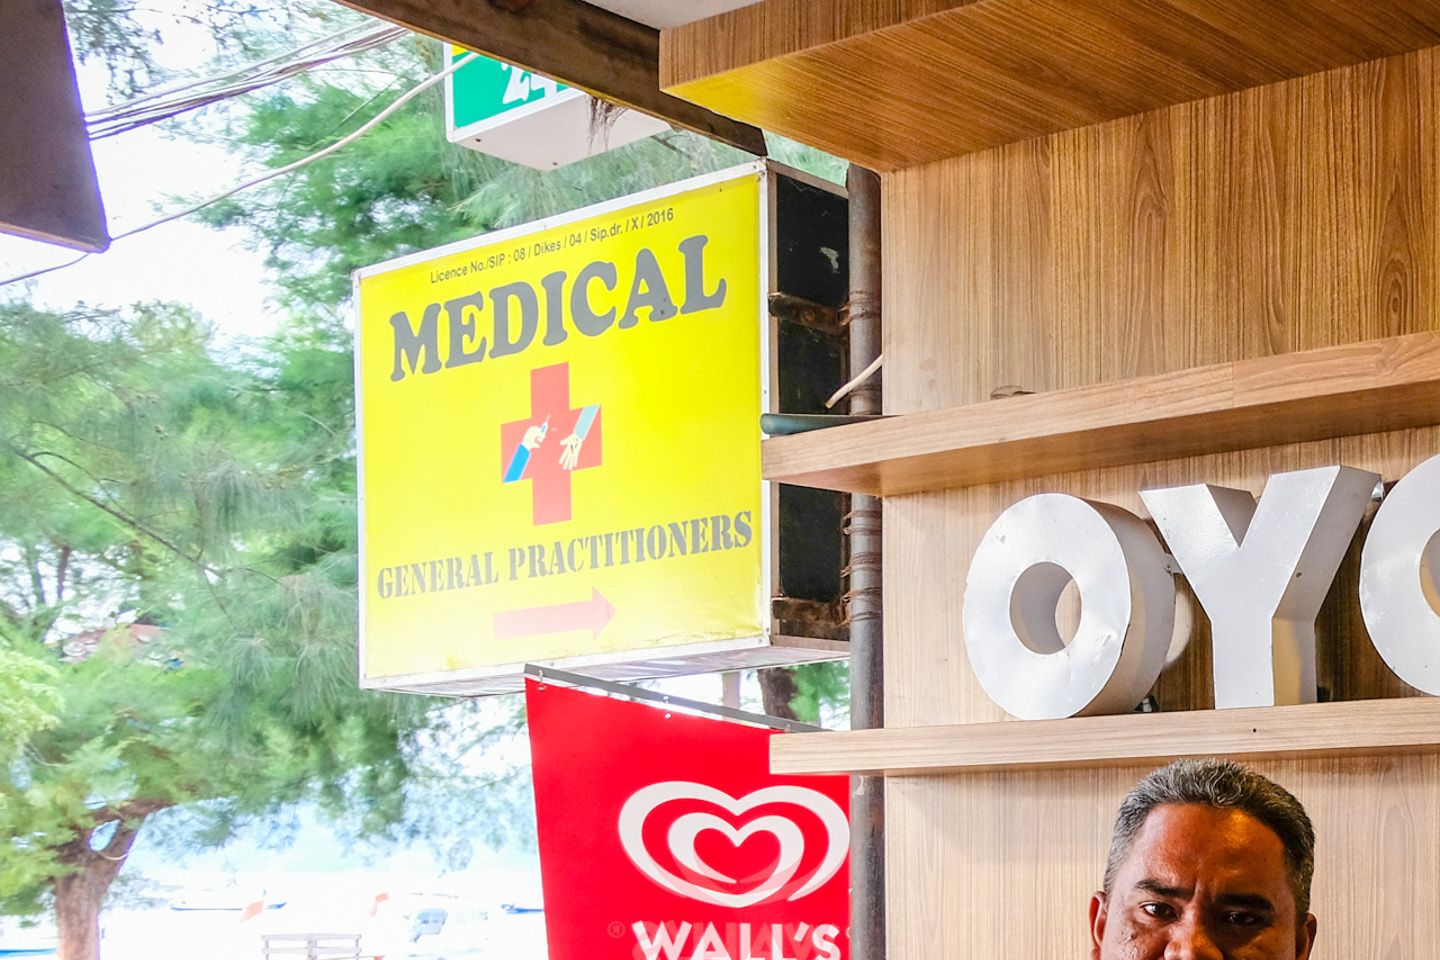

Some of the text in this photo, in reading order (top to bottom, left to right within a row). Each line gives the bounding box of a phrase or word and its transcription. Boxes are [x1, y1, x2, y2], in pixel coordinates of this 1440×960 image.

[430, 264, 468, 284] Licence
[513, 248, 526, 262] 08
[533, 239, 561, 257] Dikes
[569, 234, 582, 247] 04
[631, 216, 639, 230] X
[647, 208, 674, 228] 2016
[389, 234, 727, 382] MEDICAL
[377, 510, 753, 600] GENERAL PRACTITIONERS
